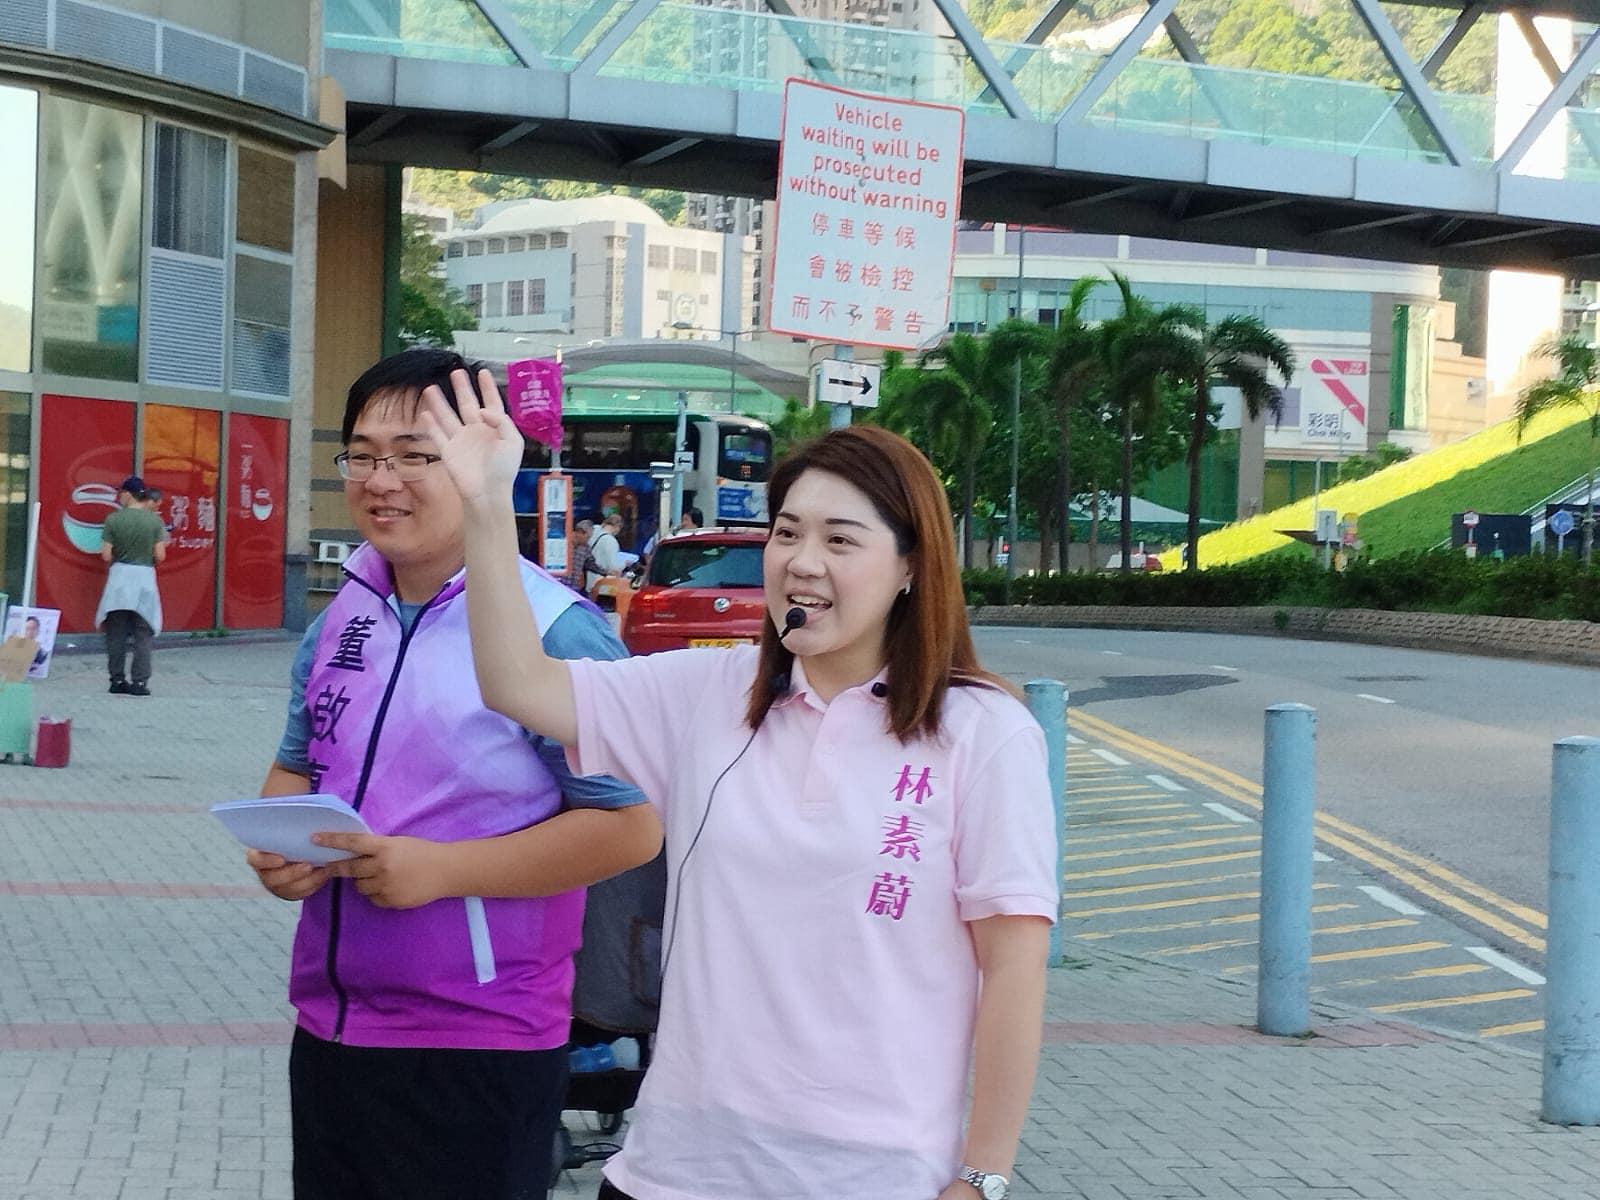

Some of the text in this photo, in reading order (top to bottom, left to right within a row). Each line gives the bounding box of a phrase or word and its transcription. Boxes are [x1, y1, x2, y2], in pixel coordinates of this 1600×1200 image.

[835, 102, 902, 132] Vehicle
[802, 125, 940, 162] waiting will be
[814, 155, 922, 186] prosecuted
[790, 175, 947, 219] without warning
[811, 212, 916, 250] 停車等候
[808, 254, 914, 292] 會被檢控
[792, 295, 926, 334] 而不予警告
[865, 764, 940, 921] 林素蔚
